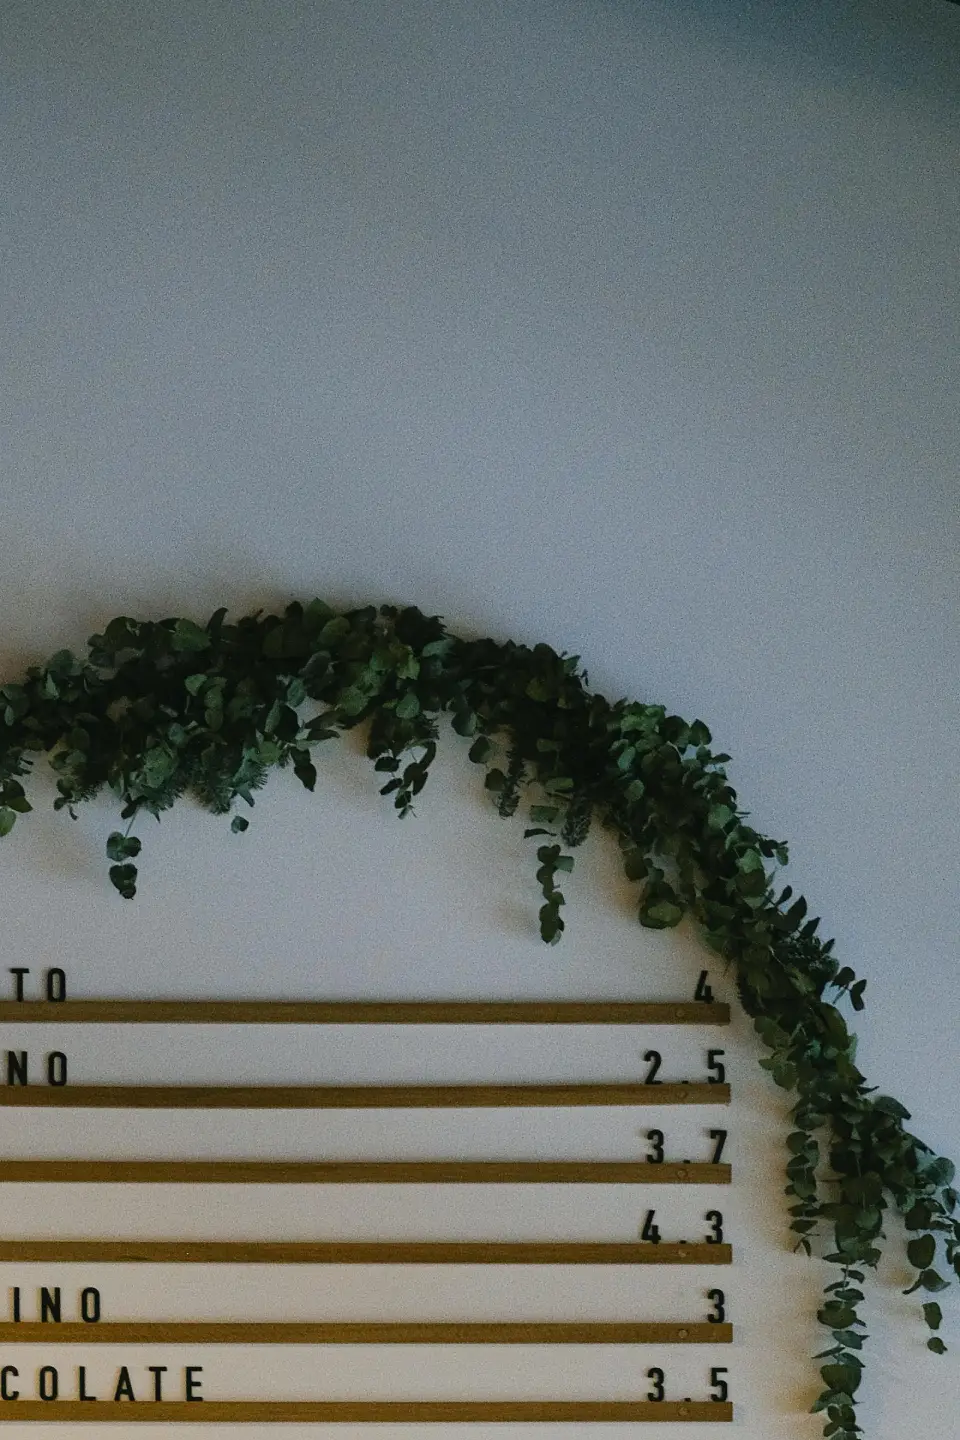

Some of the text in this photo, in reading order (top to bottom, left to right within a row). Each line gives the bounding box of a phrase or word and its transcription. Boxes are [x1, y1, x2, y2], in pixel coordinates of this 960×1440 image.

[694, 970, 714, 1003] 4
[643, 1050, 726, 1084] 2.5
[646, 1129, 728, 1164] 3.7
[641, 1210, 723, 1244] 4.3
[707, 1288, 725, 1323] 3
[647, 1367, 728, 1402] 3.5
